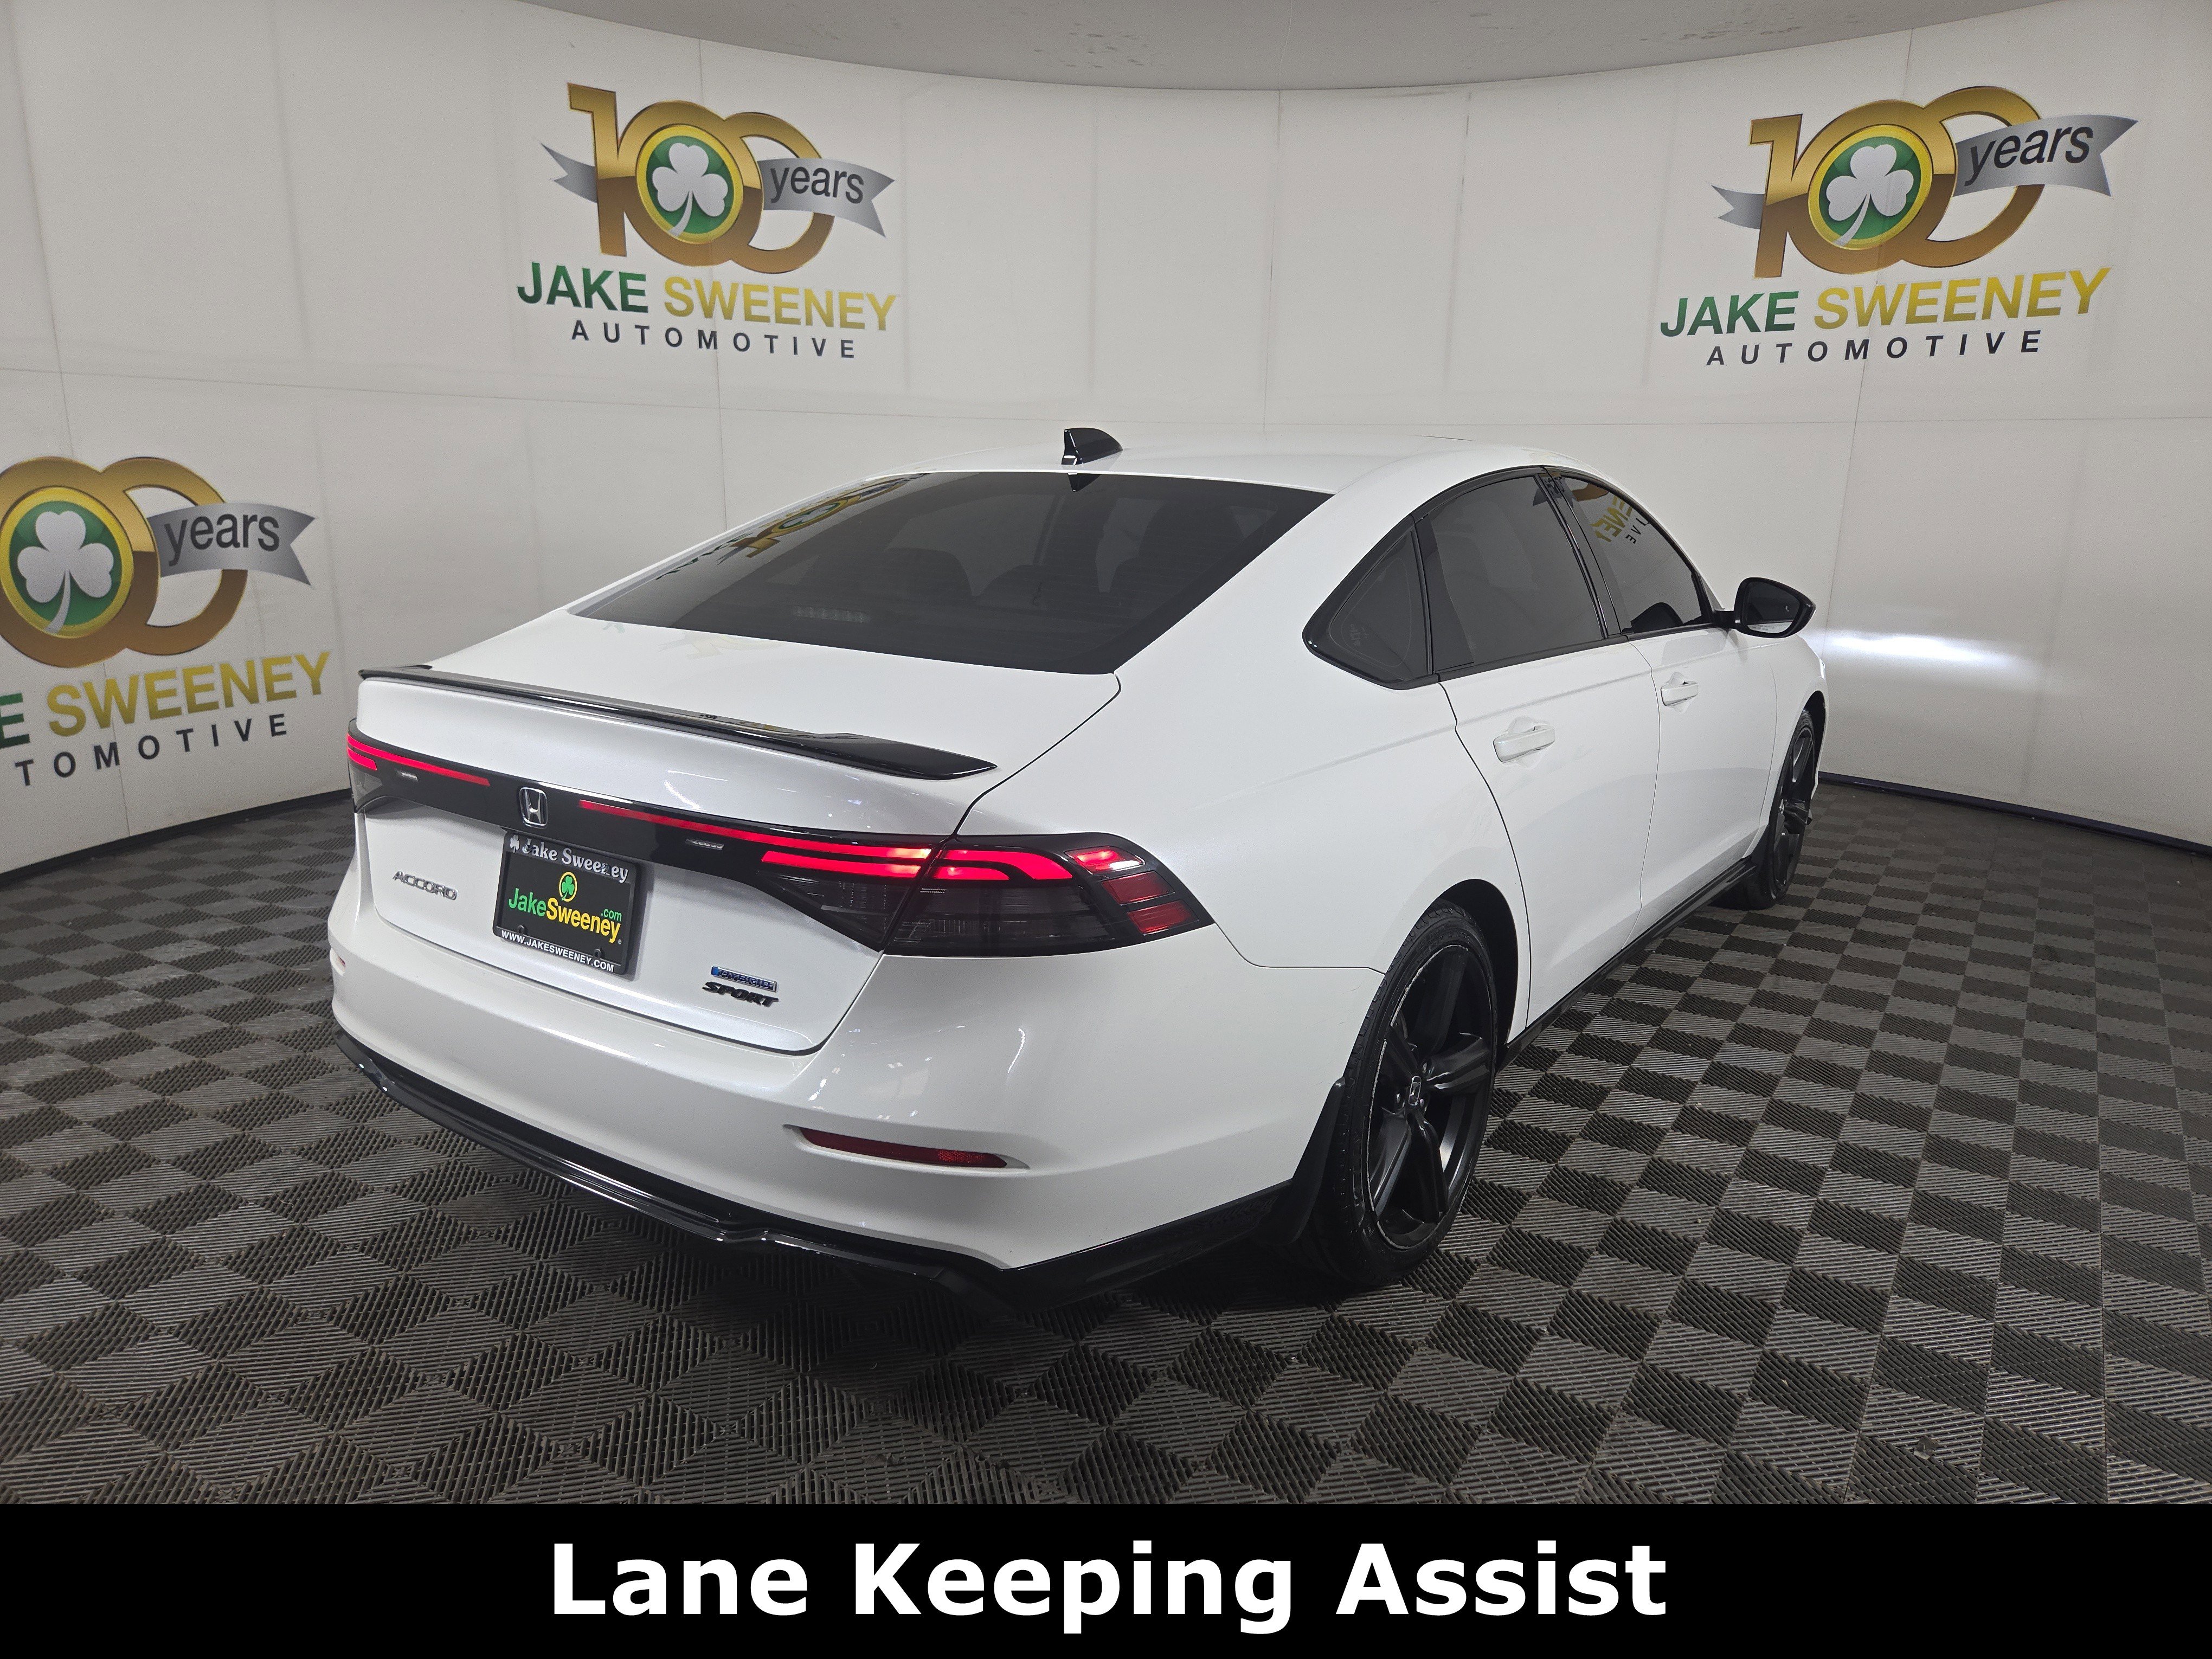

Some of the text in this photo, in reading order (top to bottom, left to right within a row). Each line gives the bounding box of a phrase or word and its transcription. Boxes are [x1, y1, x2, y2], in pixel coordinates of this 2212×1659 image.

[1964, 125, 2093, 185] years
[769, 165, 865, 204] years
[517, 261, 897, 331] JAKE SWEENEY
[1660, 267, 2111, 337] JAKE SWEENEY
[571, 320, 854, 358] AUTOMOTIVE
[1706, 330, 2041, 366] AUTOMOTIVE
[165, 513, 280, 566] years
[47, 652, 330, 737] SWEENEY
[15, 713, 287, 787] TOMOTIVE
[522, 838, 557, 861] Jake
[393, 871, 457, 900] ACCORD
[501, 930, 614, 973] WWW.JAKESWEENEY.COM
[702, 982, 779, 1007] SPORT
